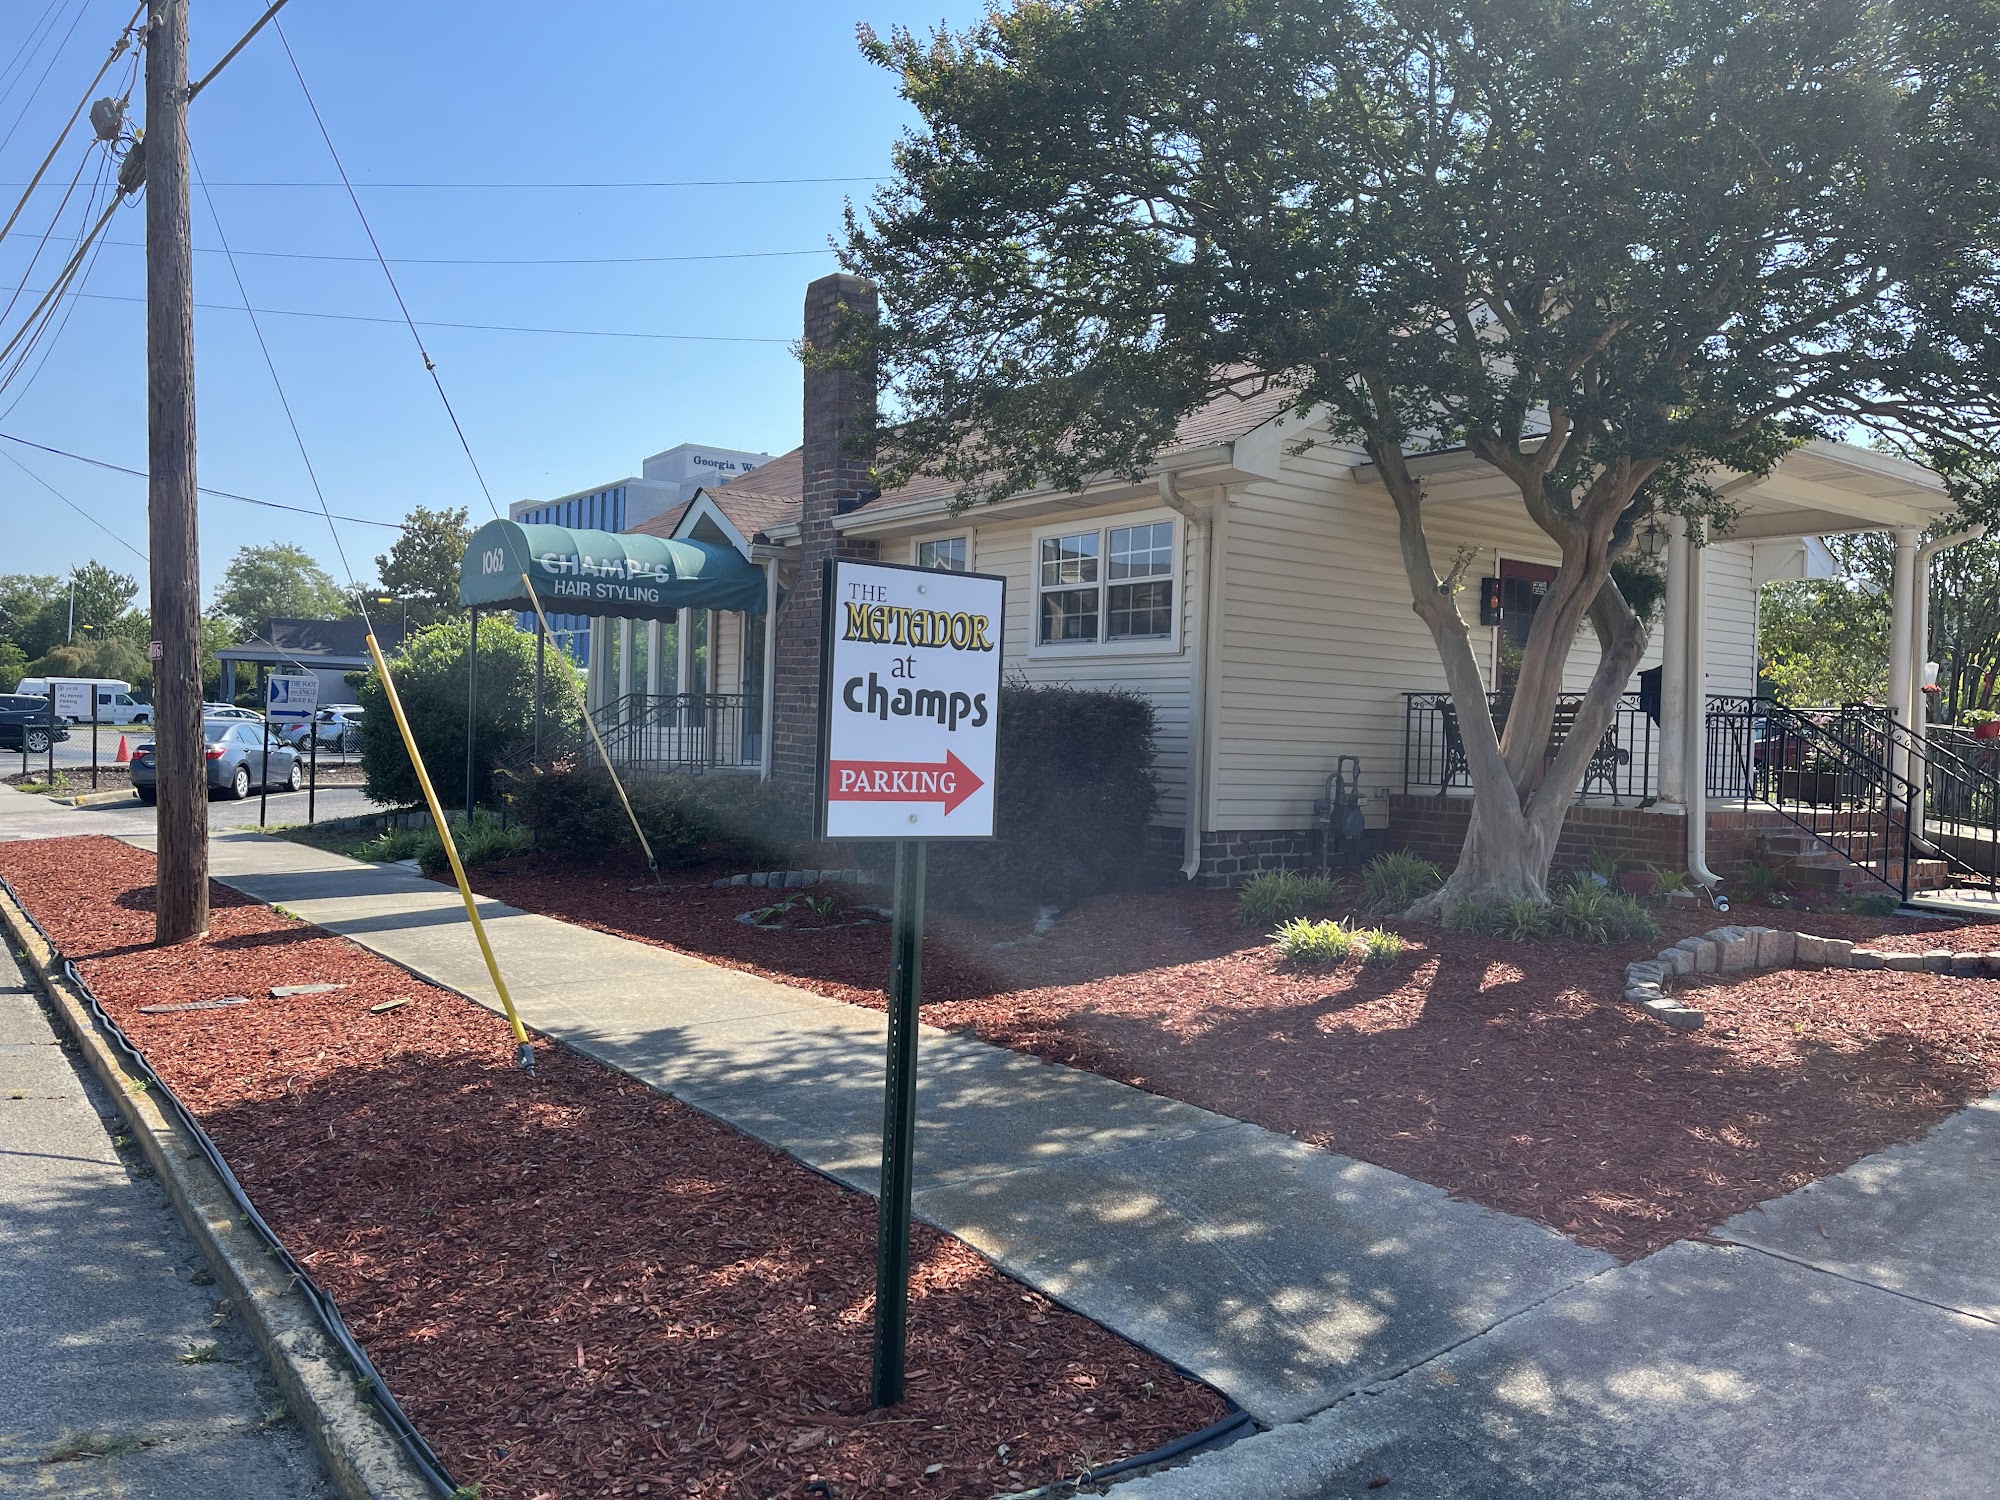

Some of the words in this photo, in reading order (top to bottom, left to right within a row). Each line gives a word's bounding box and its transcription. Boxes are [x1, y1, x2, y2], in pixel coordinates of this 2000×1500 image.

[693, 455, 736, 470] Georgia
[482, 547, 505, 576] 1062
[540, 552, 670, 584] CHAMP'S
[554, 580, 591, 597] HAIR
[596, 584, 660, 603] STYLING
[848, 582, 887, 602] THE
[842, 601, 995, 652] MATADOR
[891, 654, 917, 679] at
[843, 672, 988, 732] Champs
[839, 769, 957, 794] PARKING
